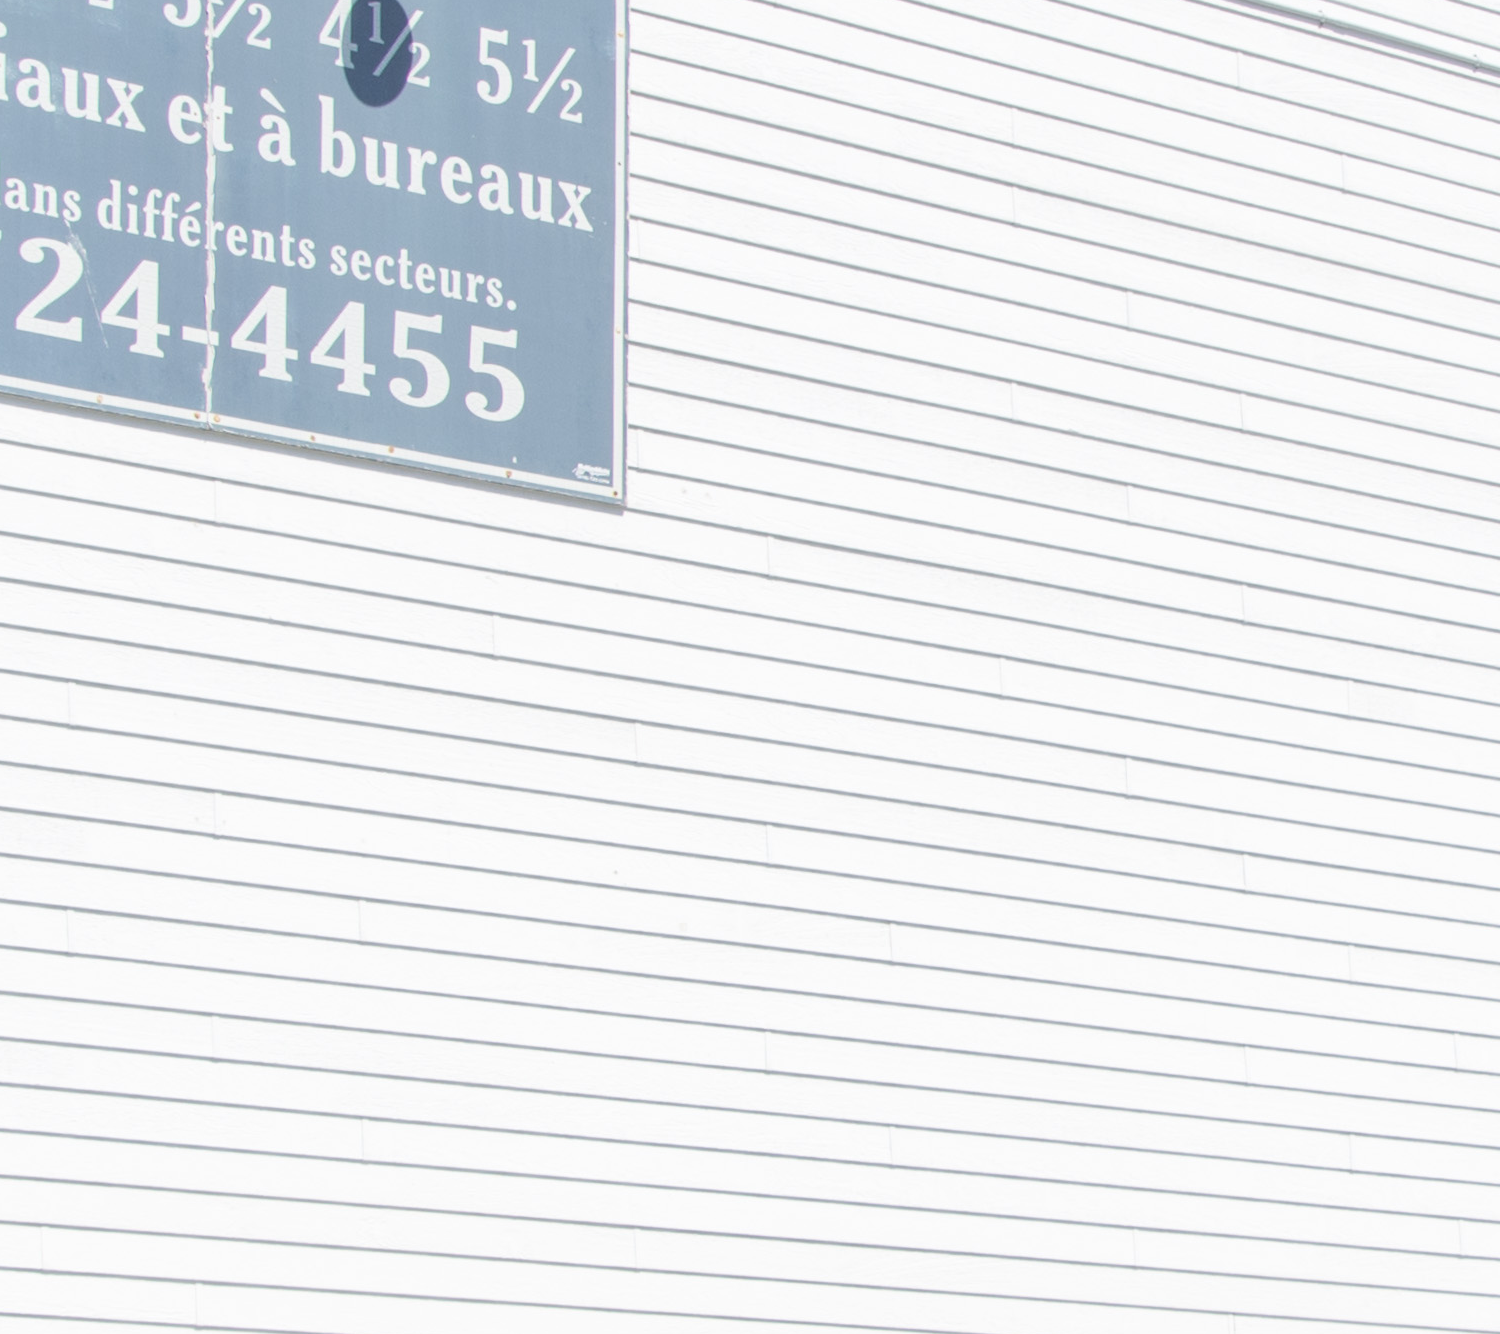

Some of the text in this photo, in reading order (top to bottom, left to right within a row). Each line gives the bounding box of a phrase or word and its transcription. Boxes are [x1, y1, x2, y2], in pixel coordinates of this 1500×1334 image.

[167, 84, 234, 153] et
[257, 88, 296, 167] à
[319, 95, 594, 233] bureaux
[97, 179, 316, 271] différents
[329, 241, 518, 312] secteurs.
